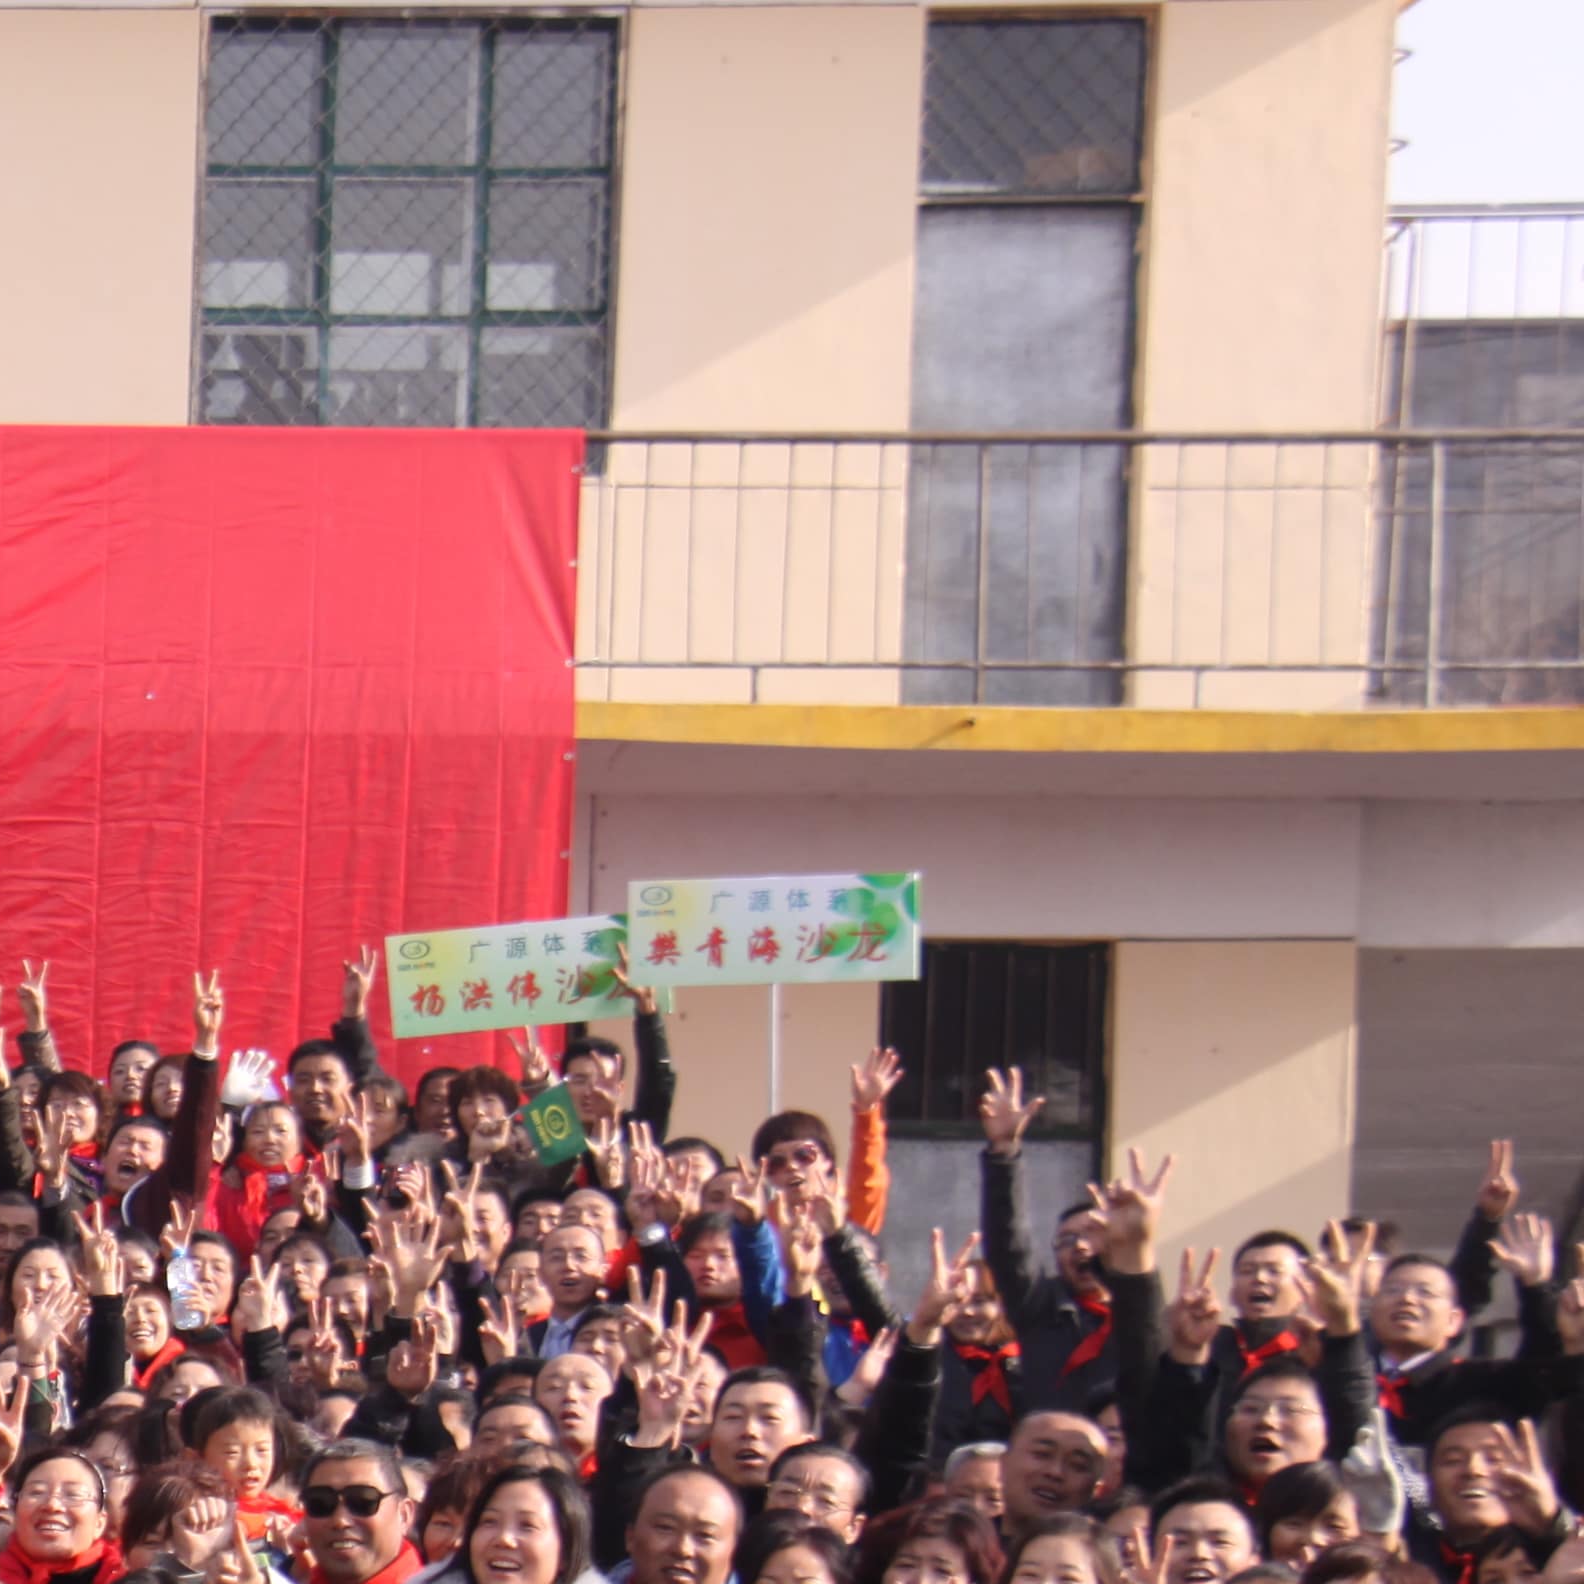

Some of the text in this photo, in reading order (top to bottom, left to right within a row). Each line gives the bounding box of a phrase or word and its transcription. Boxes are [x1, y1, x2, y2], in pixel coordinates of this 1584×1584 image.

[707, 887, 850, 914] 广源体系
[468, 929, 603, 963] 广源体系
